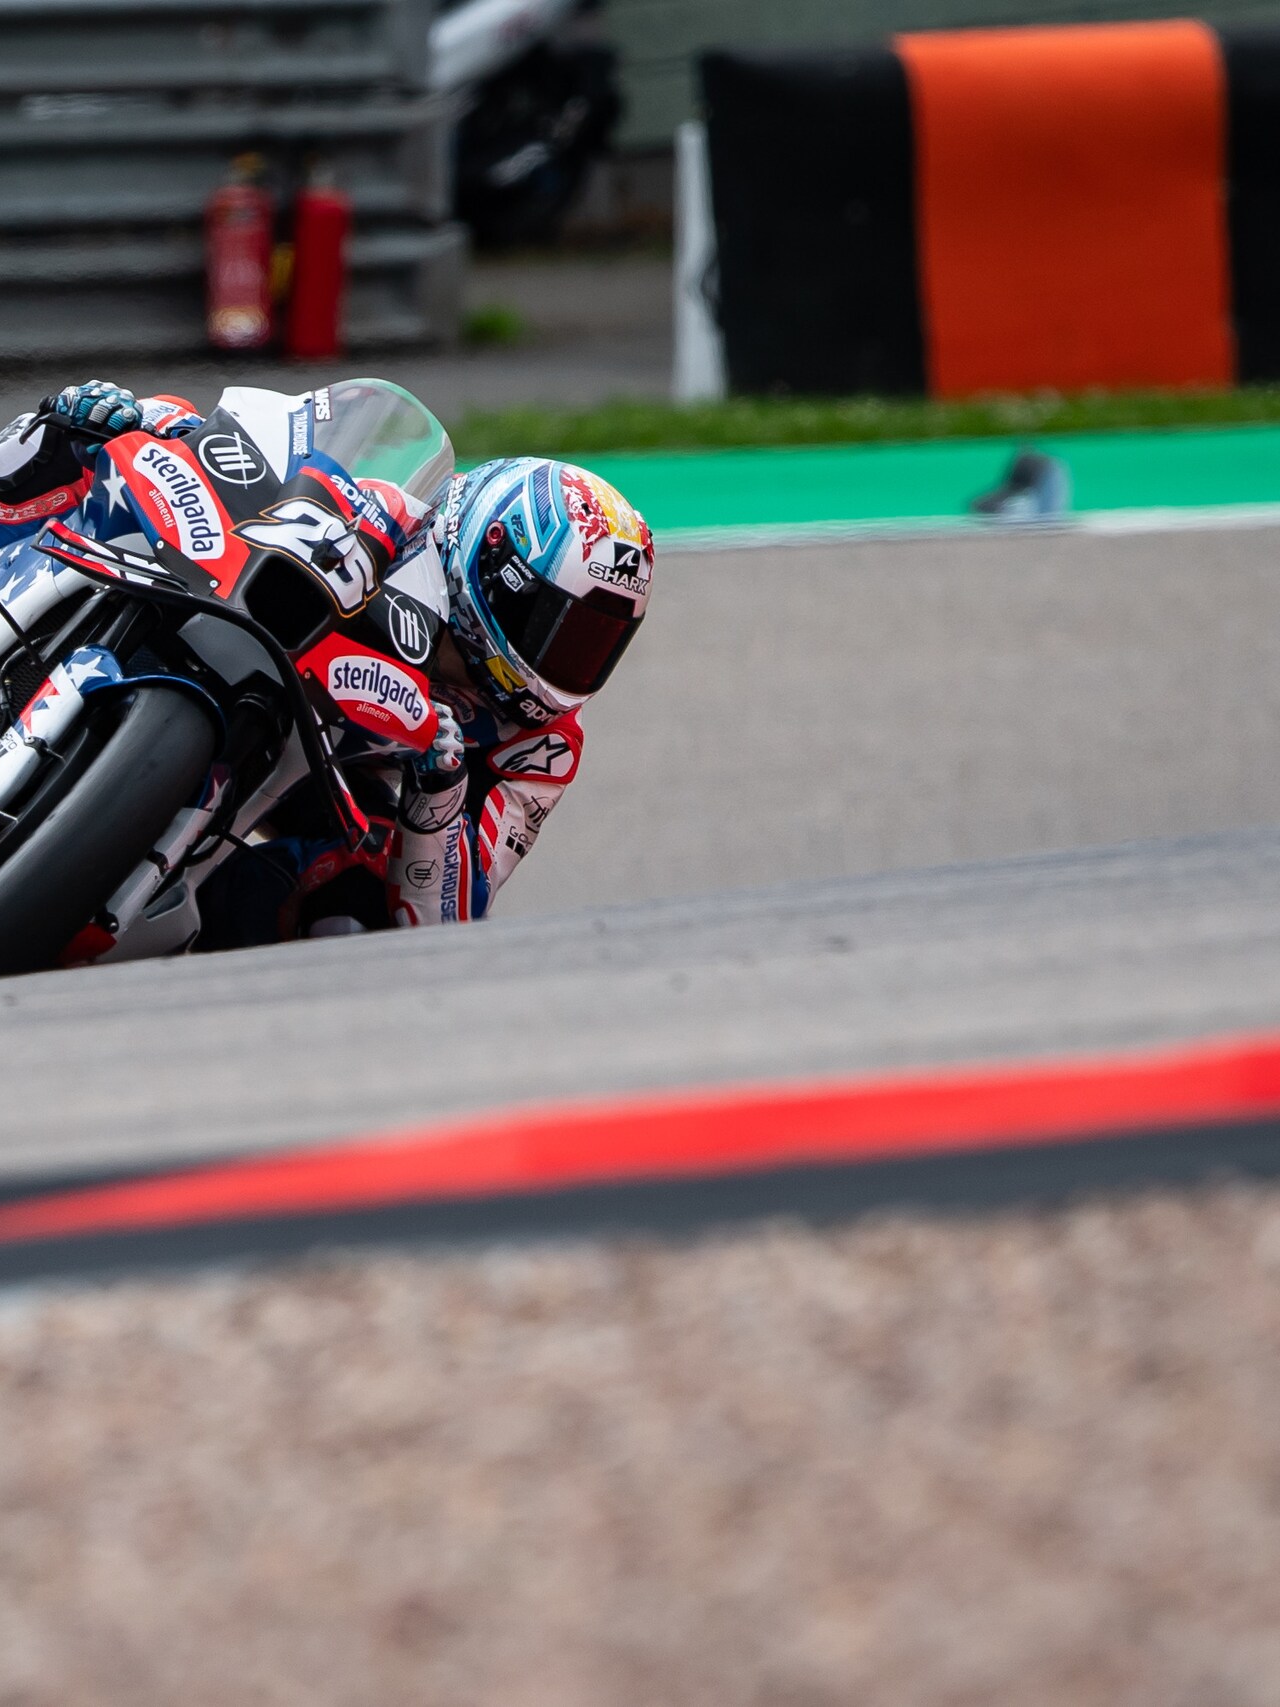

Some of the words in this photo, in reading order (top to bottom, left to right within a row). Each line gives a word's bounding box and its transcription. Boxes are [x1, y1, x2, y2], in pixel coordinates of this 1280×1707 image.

[314, 388, 331, 420] WRS
[293, 410, 308, 456] TRACKHOUSE
[141, 448, 221, 552] sterilgarda
[148, 488, 177, 528] alimenti
[330, 474, 388, 533] aprilia
[233, 498, 377, 614] 25
[504, 567, 521, 588] 100%
[511, 555, 536, 580] SHARK
[588, 561, 649, 595] SHARK
[333, 661, 423, 721] sterilgarda
[356, 702, 392, 723] alimenti
[440, 820, 461, 923] TRACKHOUSE
